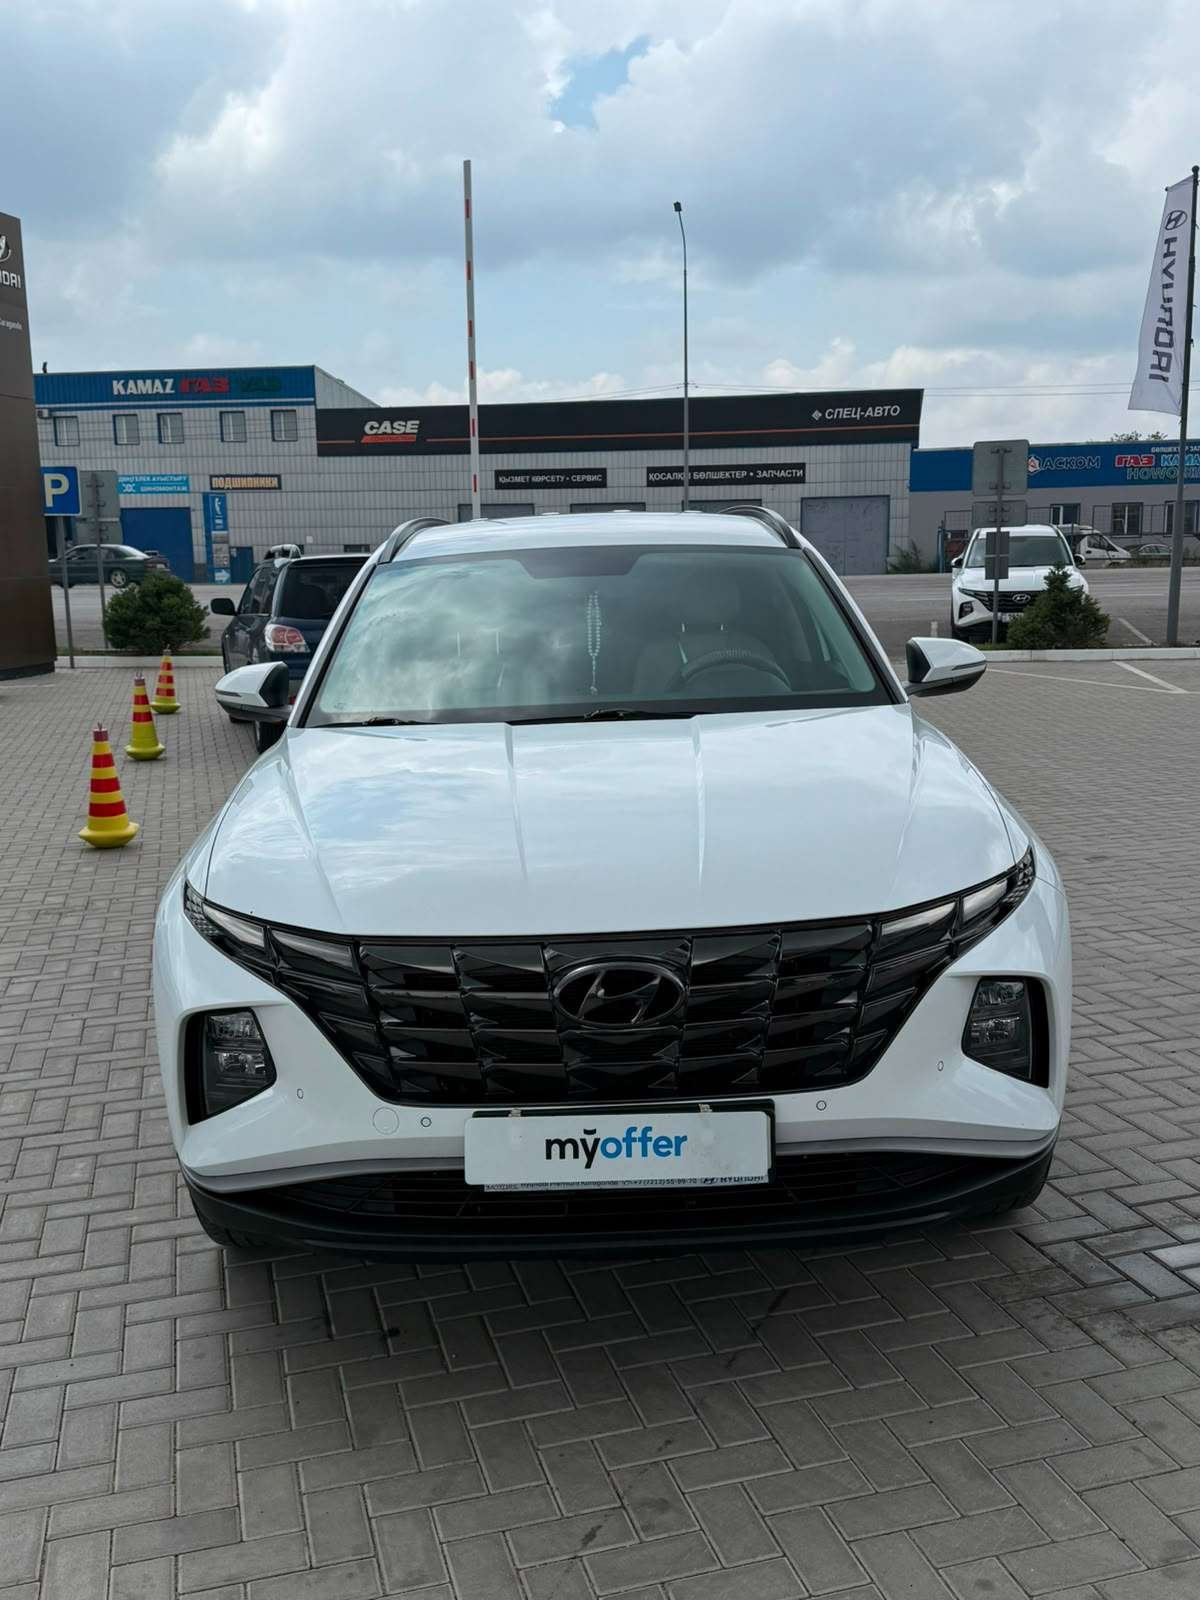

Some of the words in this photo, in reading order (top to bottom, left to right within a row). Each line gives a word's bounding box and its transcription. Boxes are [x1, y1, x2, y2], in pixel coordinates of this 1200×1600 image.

[0, 270, 21, 288] DAI
[1148, 236, 1178, 383] HYUNDAI
[112, 378, 175, 395] KAMAZ
[180, 377, 230, 393] ГАЗ
[825, 405, 901, 420] СПЕЦ-АВТО
[364, 420, 420, 434] CASE
[1115, 454, 1155, 467] ГАЗ
[571, 474, 602, 482] СЕРВИС
[756, 469, 803, 478] ЗАПЧАСТИ
[43, 472, 70, 508] P
